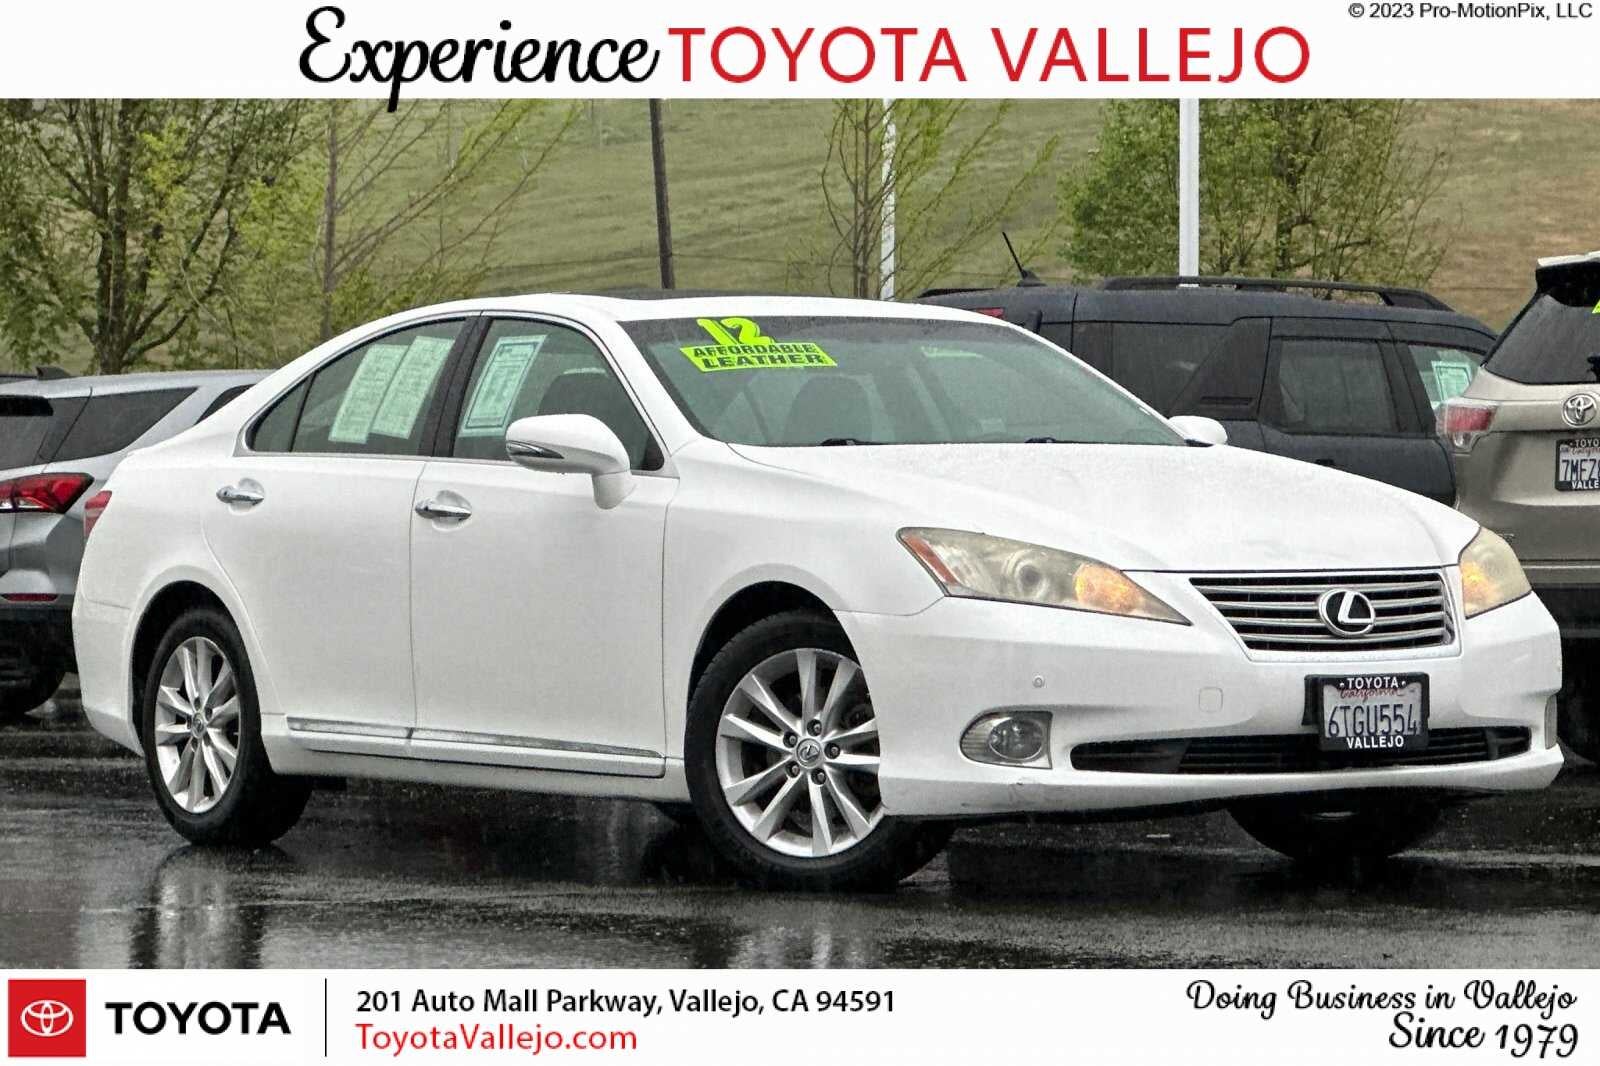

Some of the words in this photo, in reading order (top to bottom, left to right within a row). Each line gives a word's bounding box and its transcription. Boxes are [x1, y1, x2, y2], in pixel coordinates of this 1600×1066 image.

[696, 317, 775, 345] 12
[693, 343, 818, 357] AFFORDABLE
[703, 354, 824, 369] LEATHER
[1347, 677, 1399, 689] TOYOTA
[1328, 703, 1418, 737] 6TGU554
[1346, 735, 1405, 749] VALLEJO
